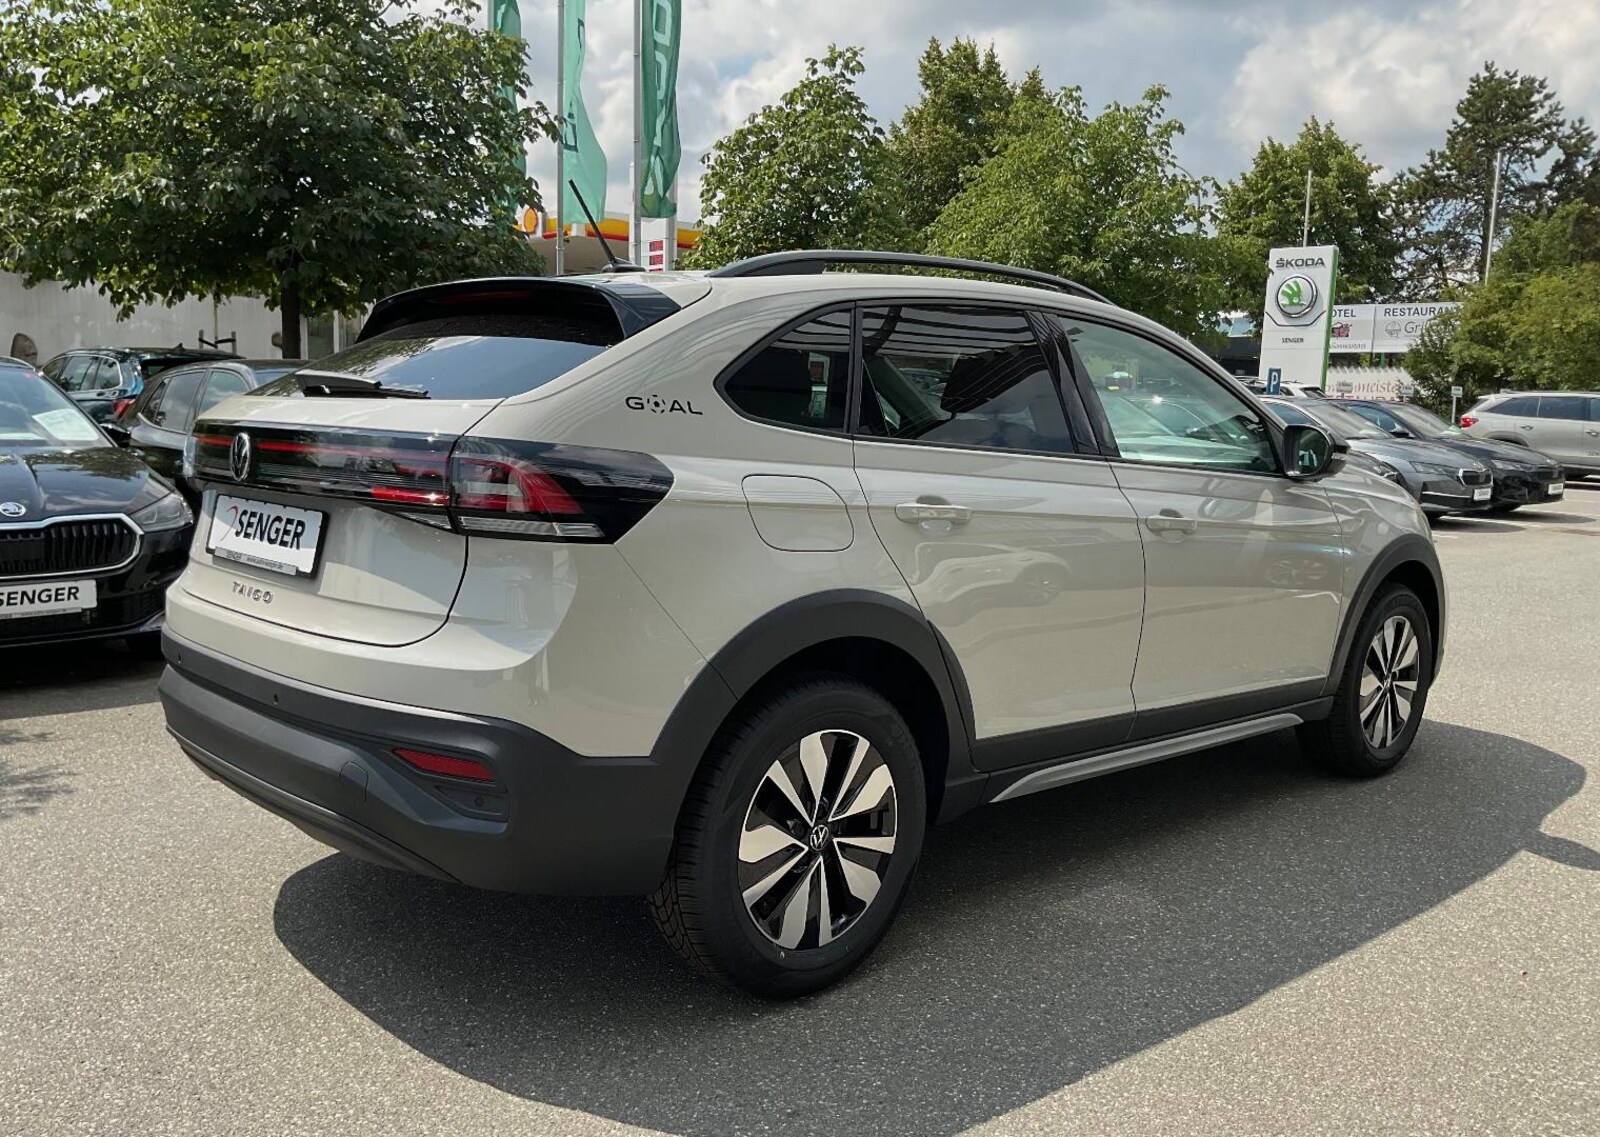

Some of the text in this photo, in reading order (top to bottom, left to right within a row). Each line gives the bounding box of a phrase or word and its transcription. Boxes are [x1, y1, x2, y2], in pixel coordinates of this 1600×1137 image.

[1276, 257, 1325, 268] ŠKODA
[1332, 309, 1356, 318] OTEL
[1384, 306, 1457, 317] RESTAURAN
[1270, 371, 1278, 393] P
[235, 509, 306, 550] SENGER
[233, 581, 274, 604] TAIGO
